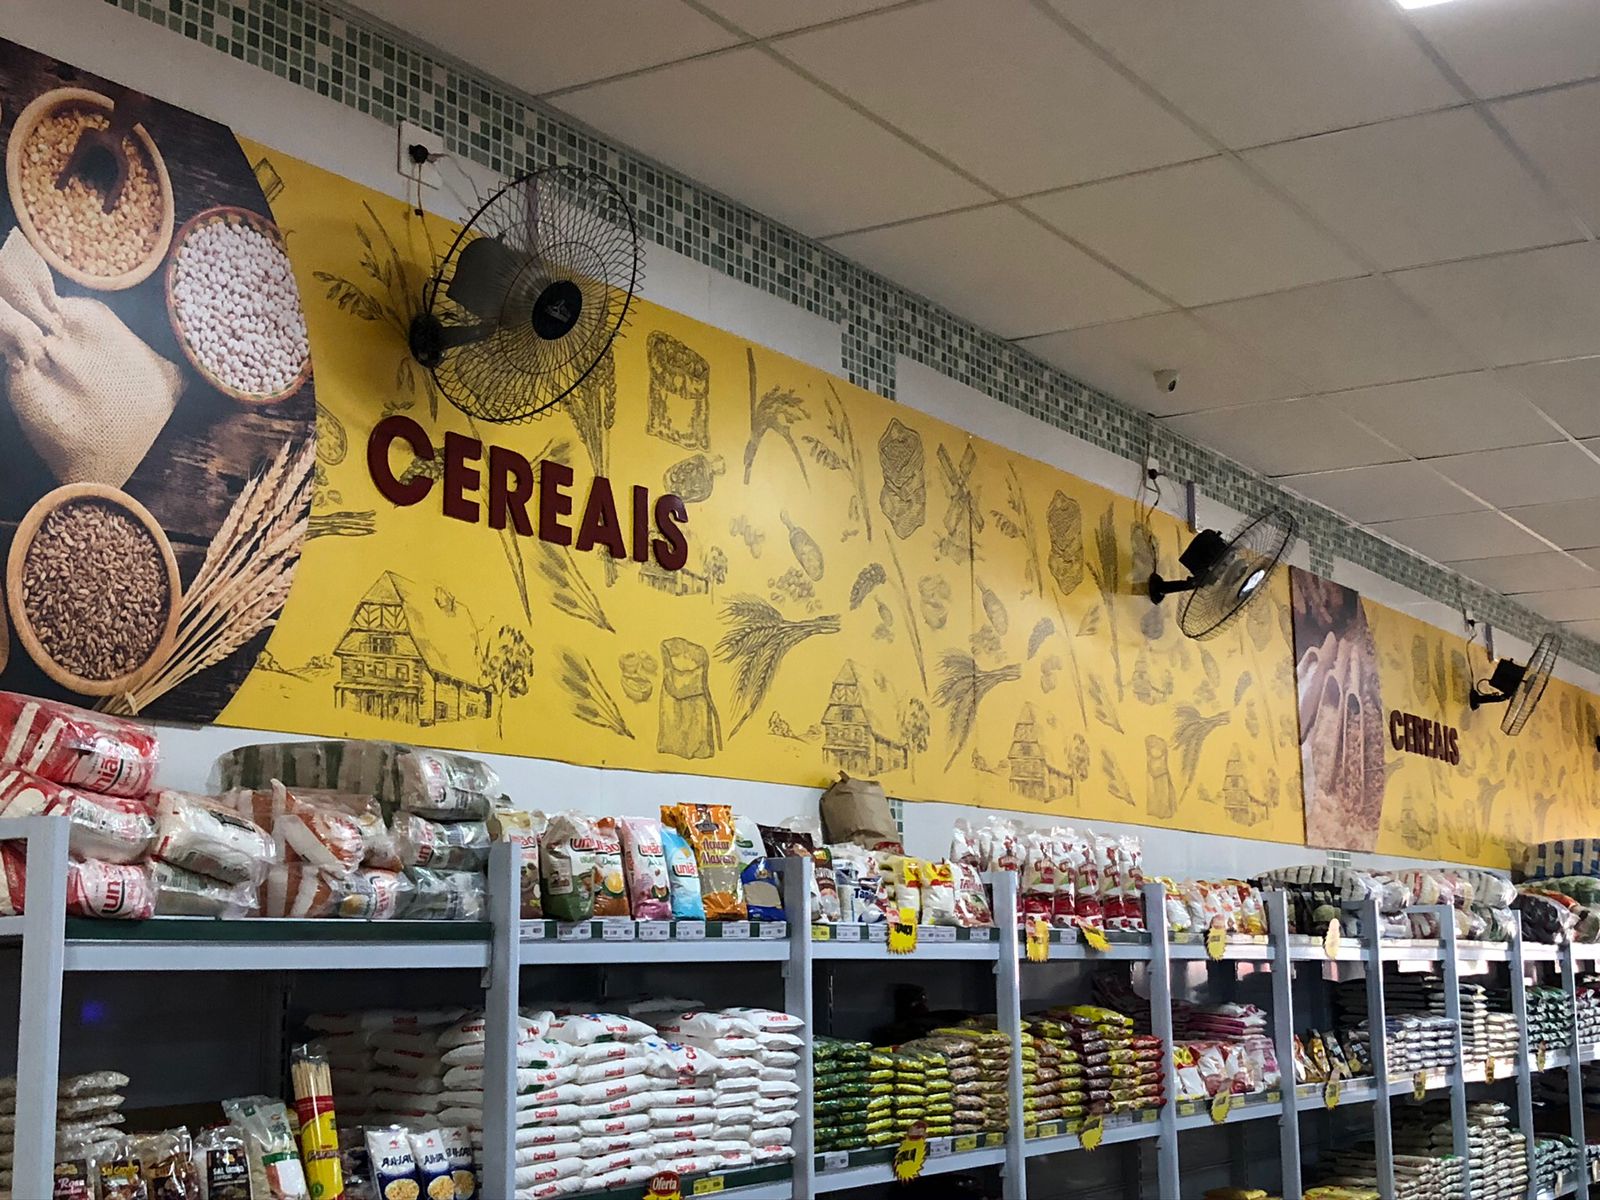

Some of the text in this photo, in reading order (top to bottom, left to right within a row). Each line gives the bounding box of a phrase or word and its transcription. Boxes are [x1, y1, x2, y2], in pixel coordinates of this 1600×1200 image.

[367, 415, 688, 571] CEREAIS
[1389, 709, 1460, 766] CEREAIS
[653, 1177, 677, 1190] Oferta
